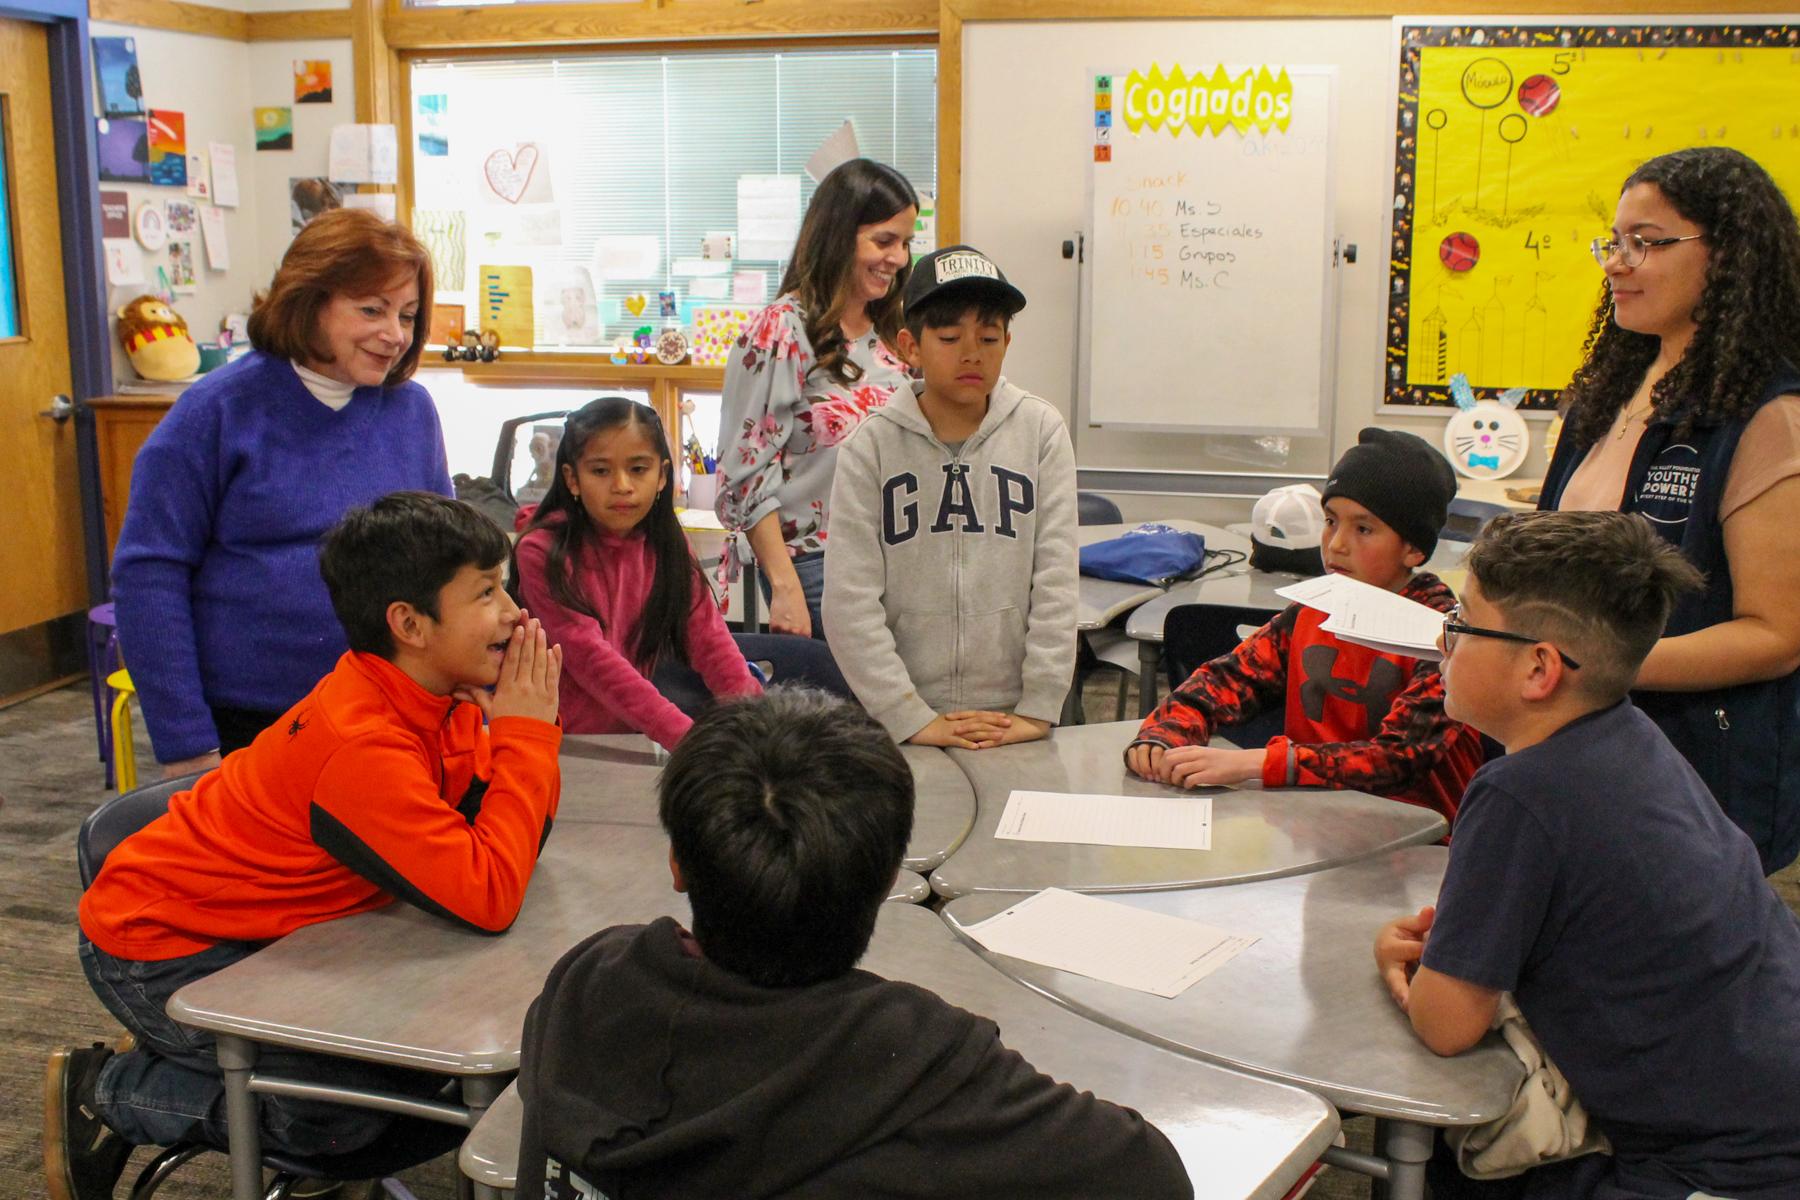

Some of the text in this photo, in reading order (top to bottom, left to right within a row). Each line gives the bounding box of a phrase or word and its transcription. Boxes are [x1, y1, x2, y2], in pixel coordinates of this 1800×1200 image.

[1126, 75, 1289, 127] Cognados
[1180, 222, 1263, 244] Especiales
[1179, 245, 1236, 264] Grupos
[940, 256, 993, 275] TRINITY
[1647, 471, 1690, 485] YOUTH
[1642, 482, 1688, 497] POWER
[882, 463, 1035, 546] GAP
